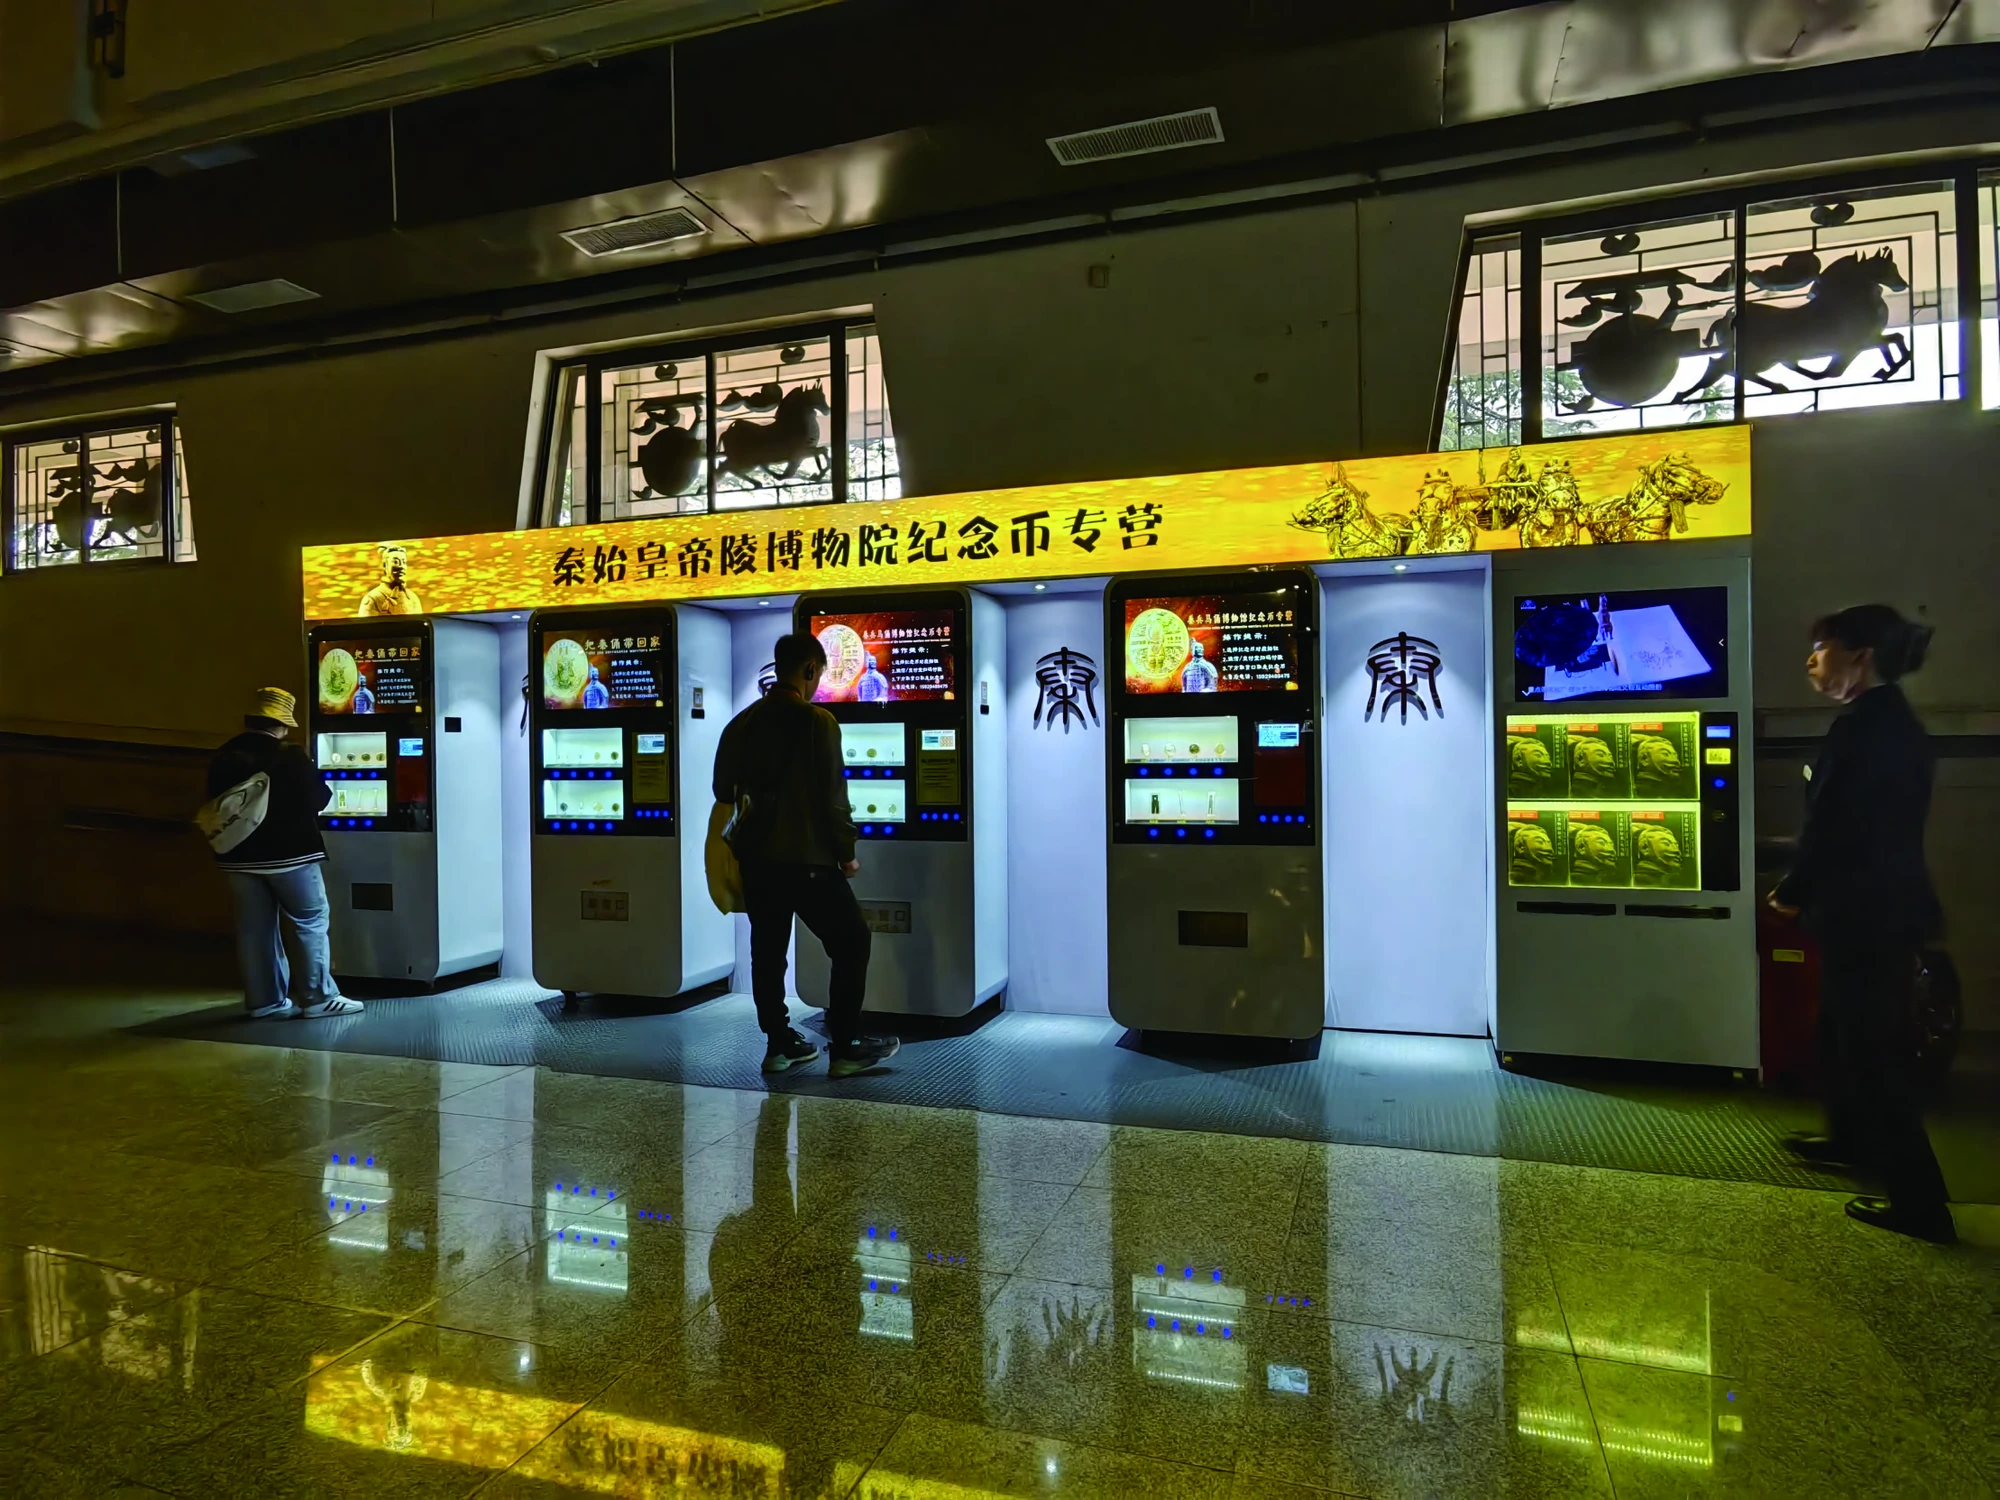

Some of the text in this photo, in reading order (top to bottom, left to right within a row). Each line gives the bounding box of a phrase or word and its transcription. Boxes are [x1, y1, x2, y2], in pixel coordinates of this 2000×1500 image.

[553, 502, 1163, 587] 秦始皇帝陵博物院纪念币专营
[585, 635, 661, 650] 把秦俑带回家
